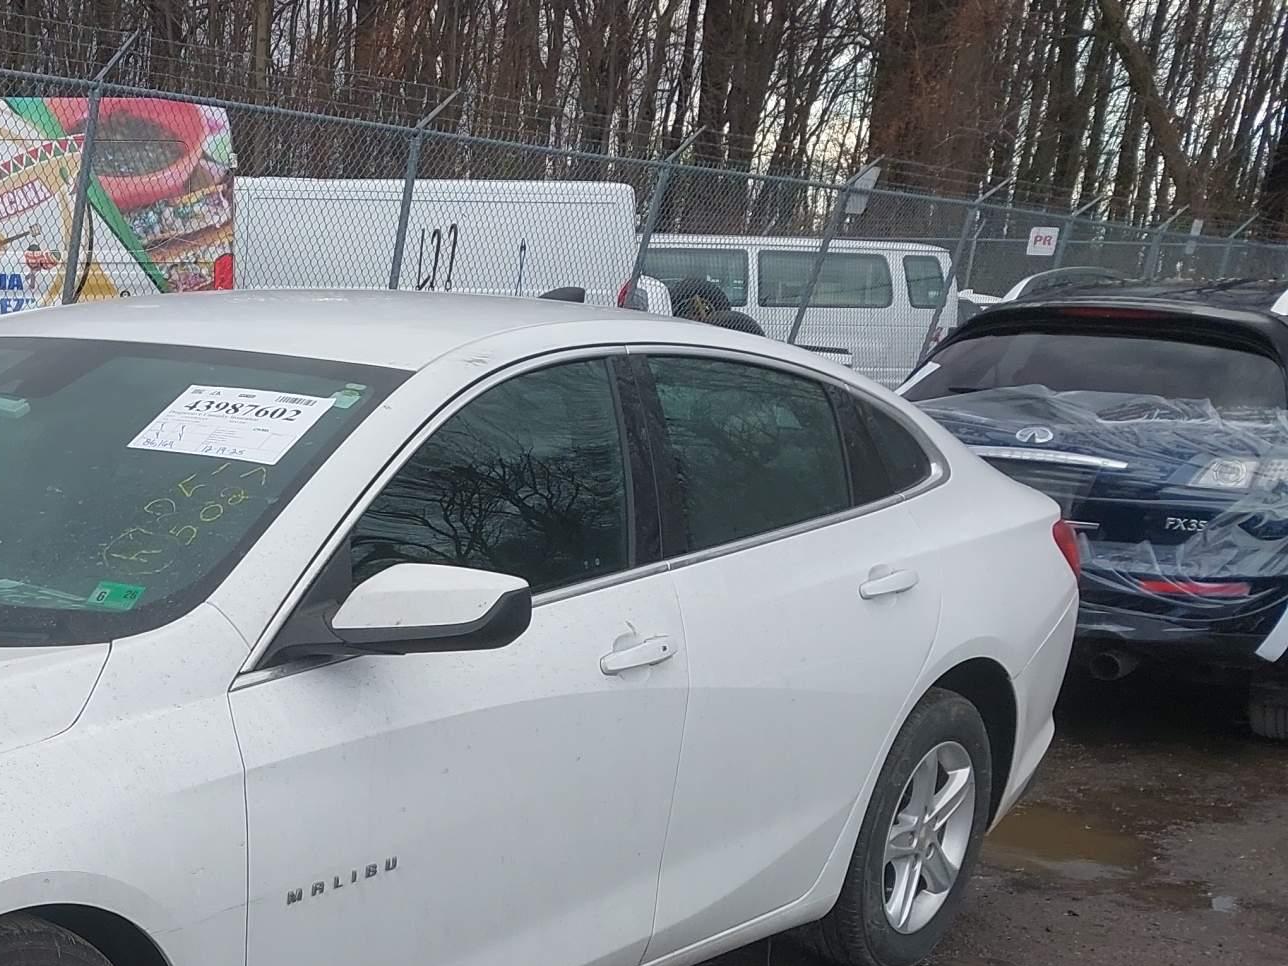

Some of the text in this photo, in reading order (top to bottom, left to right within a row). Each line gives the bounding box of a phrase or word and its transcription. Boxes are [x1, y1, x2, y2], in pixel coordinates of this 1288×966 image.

[1033, 234, 1053, 246] PR
[183, 398, 303, 422] 43987602
[1165, 516, 1210, 532] FX35
[286, 855, 399, 907] MALIBU
